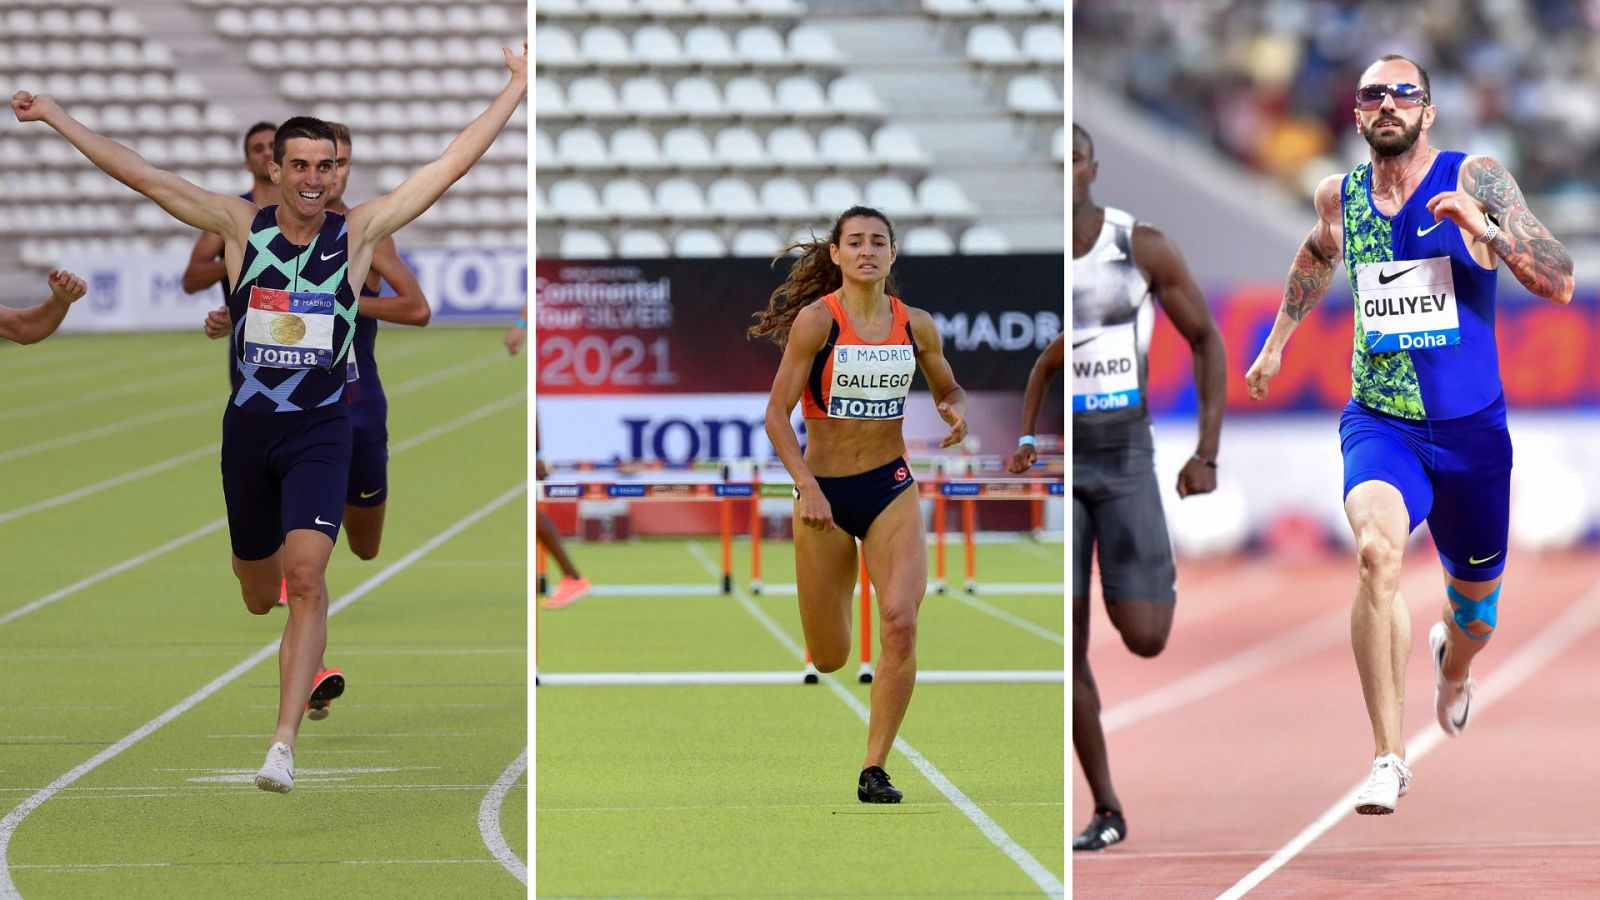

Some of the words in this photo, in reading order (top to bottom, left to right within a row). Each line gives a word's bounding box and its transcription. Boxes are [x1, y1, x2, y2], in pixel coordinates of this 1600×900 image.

[302, 299, 332, 308] MADRID
[1364, 293, 1446, 318] GULIYEV
[583, 304, 673, 328] SILVER
[1398, 332, 1447, 349] Doha
[540, 335, 679, 385] 2021
[857, 349, 912, 362] MADRID
[1073, 358, 1132, 378] WARD
[837, 374, 909, 388] GALLEGO
[1085, 394, 1129, 410] Doha
